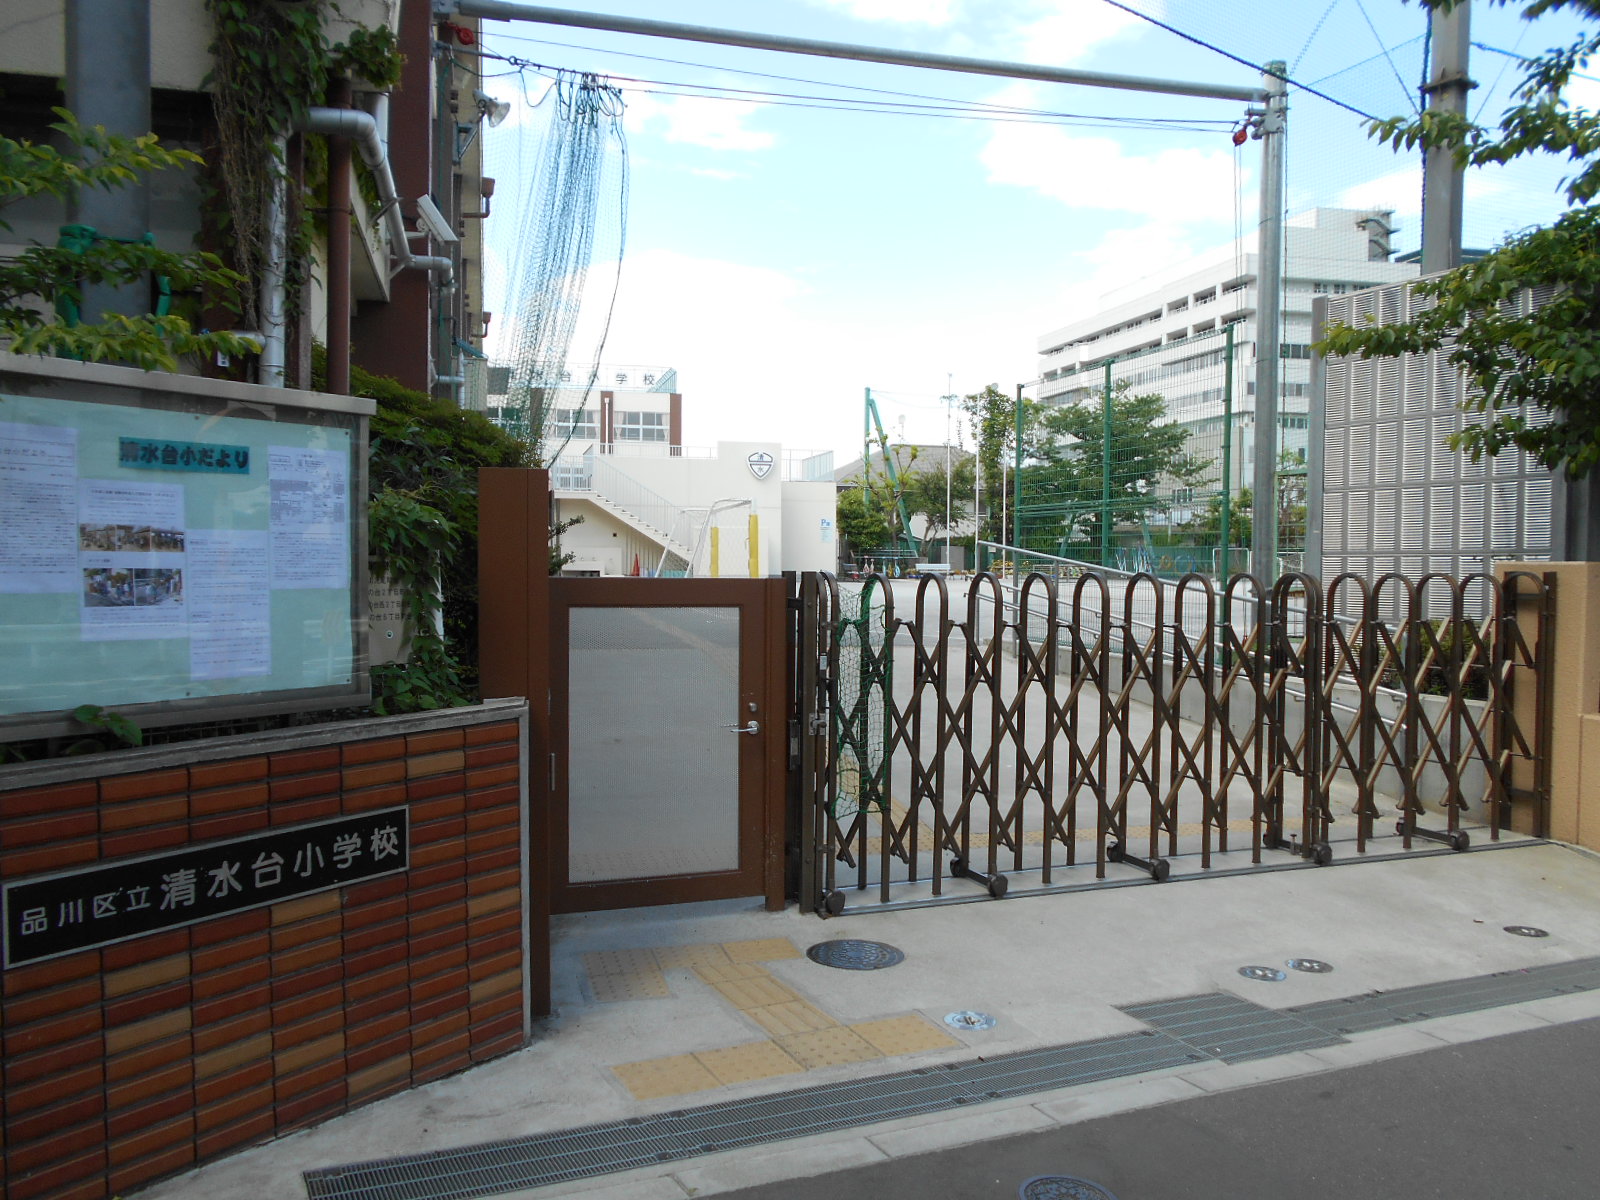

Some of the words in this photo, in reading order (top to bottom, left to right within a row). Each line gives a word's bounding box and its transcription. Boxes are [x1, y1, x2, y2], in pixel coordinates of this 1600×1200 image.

[21, 825, 399, 936] 品川区立清水台小学校
